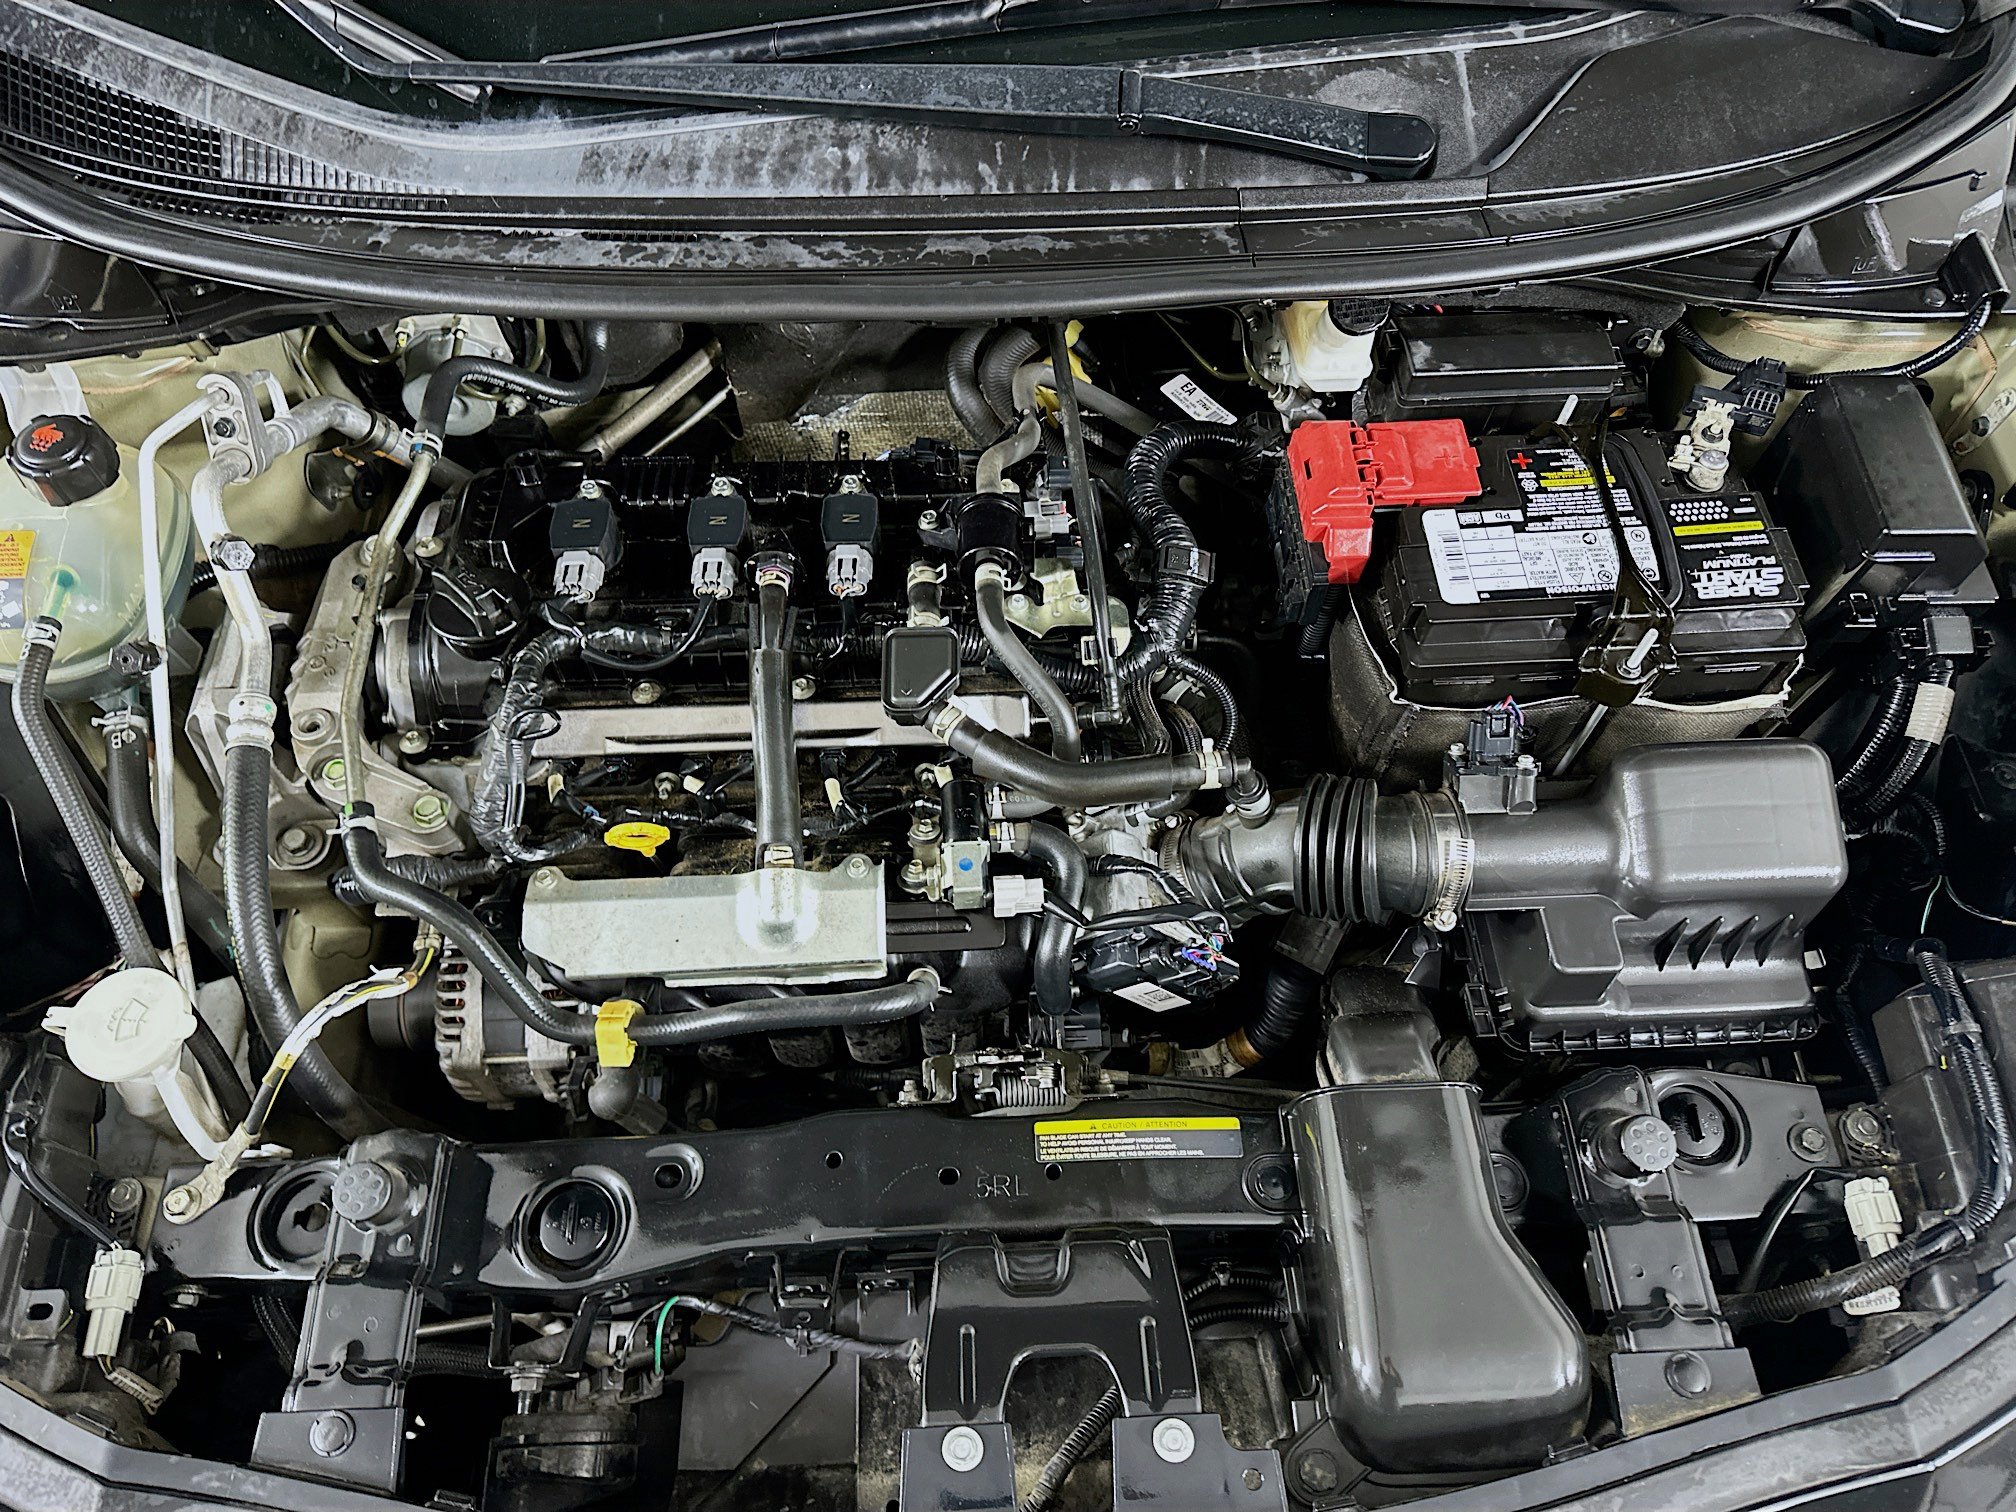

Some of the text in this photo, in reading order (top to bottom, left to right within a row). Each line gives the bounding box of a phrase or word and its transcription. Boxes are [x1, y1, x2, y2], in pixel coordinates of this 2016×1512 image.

[1180, 382, 1197, 396] EA
[1495, 512, 1511, 520] Pb
[1703, 556, 1776, 569] PLATINUM
[1546, 584, 1616, 594] NGER/POISON
[1697, 585, 1780, 599] SUPER
[1101, 1121, 1137, 1130] CAUTION
[977, 1174, 1029, 1198] 5RL
